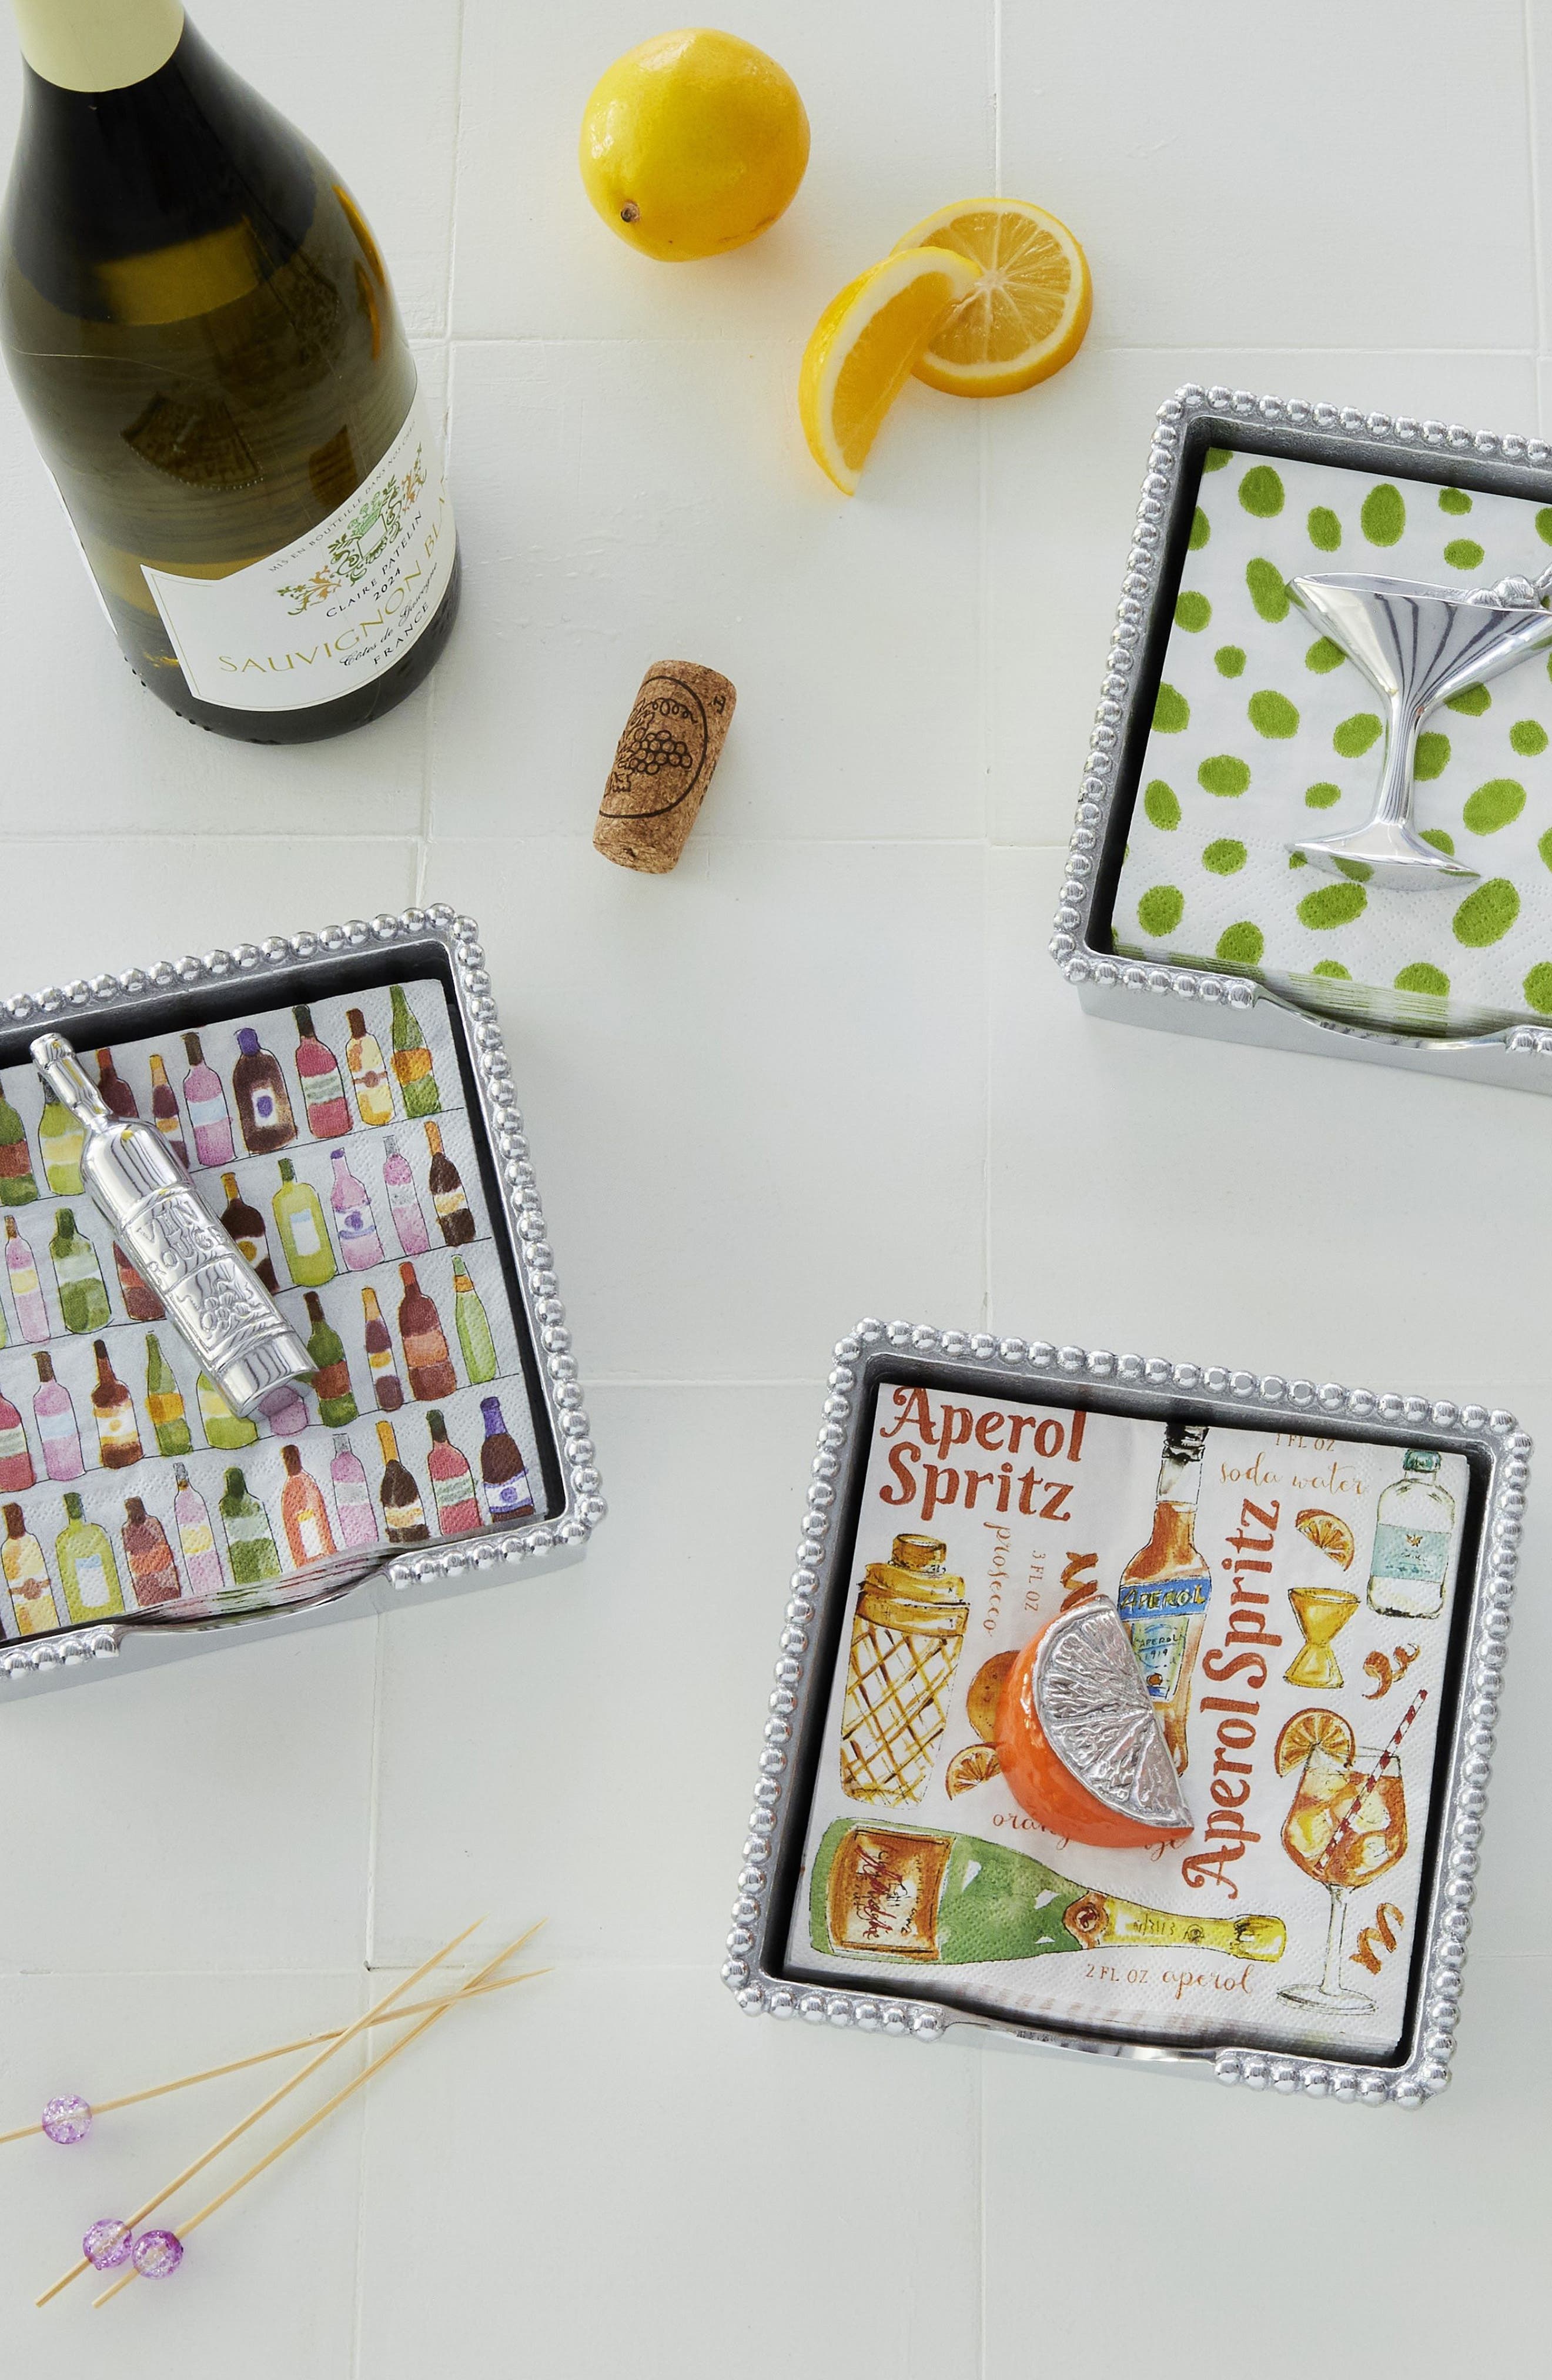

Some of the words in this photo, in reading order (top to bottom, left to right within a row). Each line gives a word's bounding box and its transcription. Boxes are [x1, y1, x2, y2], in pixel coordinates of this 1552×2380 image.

[269, 559, 289, 573] MIS
[291, 547, 306, 560] EN
[309, 498, 362, 547] BOUTEILLE
[365, 469, 386, 494] DANS
[326, 578, 378, 617] CLAIRE
[382, 510, 423, 575] PATELIN
[373, 567, 401, 602] 2024
[218, 559, 422, 673] SAUVIGNON
[373, 601, 429, 665] FRANCE
[380, 627, 393, 643] de
[136, 1200, 200, 1244] VIN
[879, 1386, 1088, 1462] Aperol
[1314, 1438, 1335, 1452] OZ
[879, 1441, 1075, 1522] Spritz
[1219, 1450, 1283, 1487] soda
[1292, 1461, 1369, 1495] water
[1029, 1564, 1045, 1584] FL
[1032, 1550, 1046, 1560] 3
[983, 1521, 1011, 1638] prosecco
[1024, 1591, 1042, 1612] OZ
[1120, 1584, 1206, 1612] APEROL
[1202, 1497, 1283, 1690] Spritz
[1181, 1695, 1262, 1900] Aperol
[1085, 1964, 1094, 1978] 2
[1099, 1965, 1119, 1982] FL
[1126, 1969, 1149, 1983] OZ
[1162, 1963, 1255, 2000] aperol
